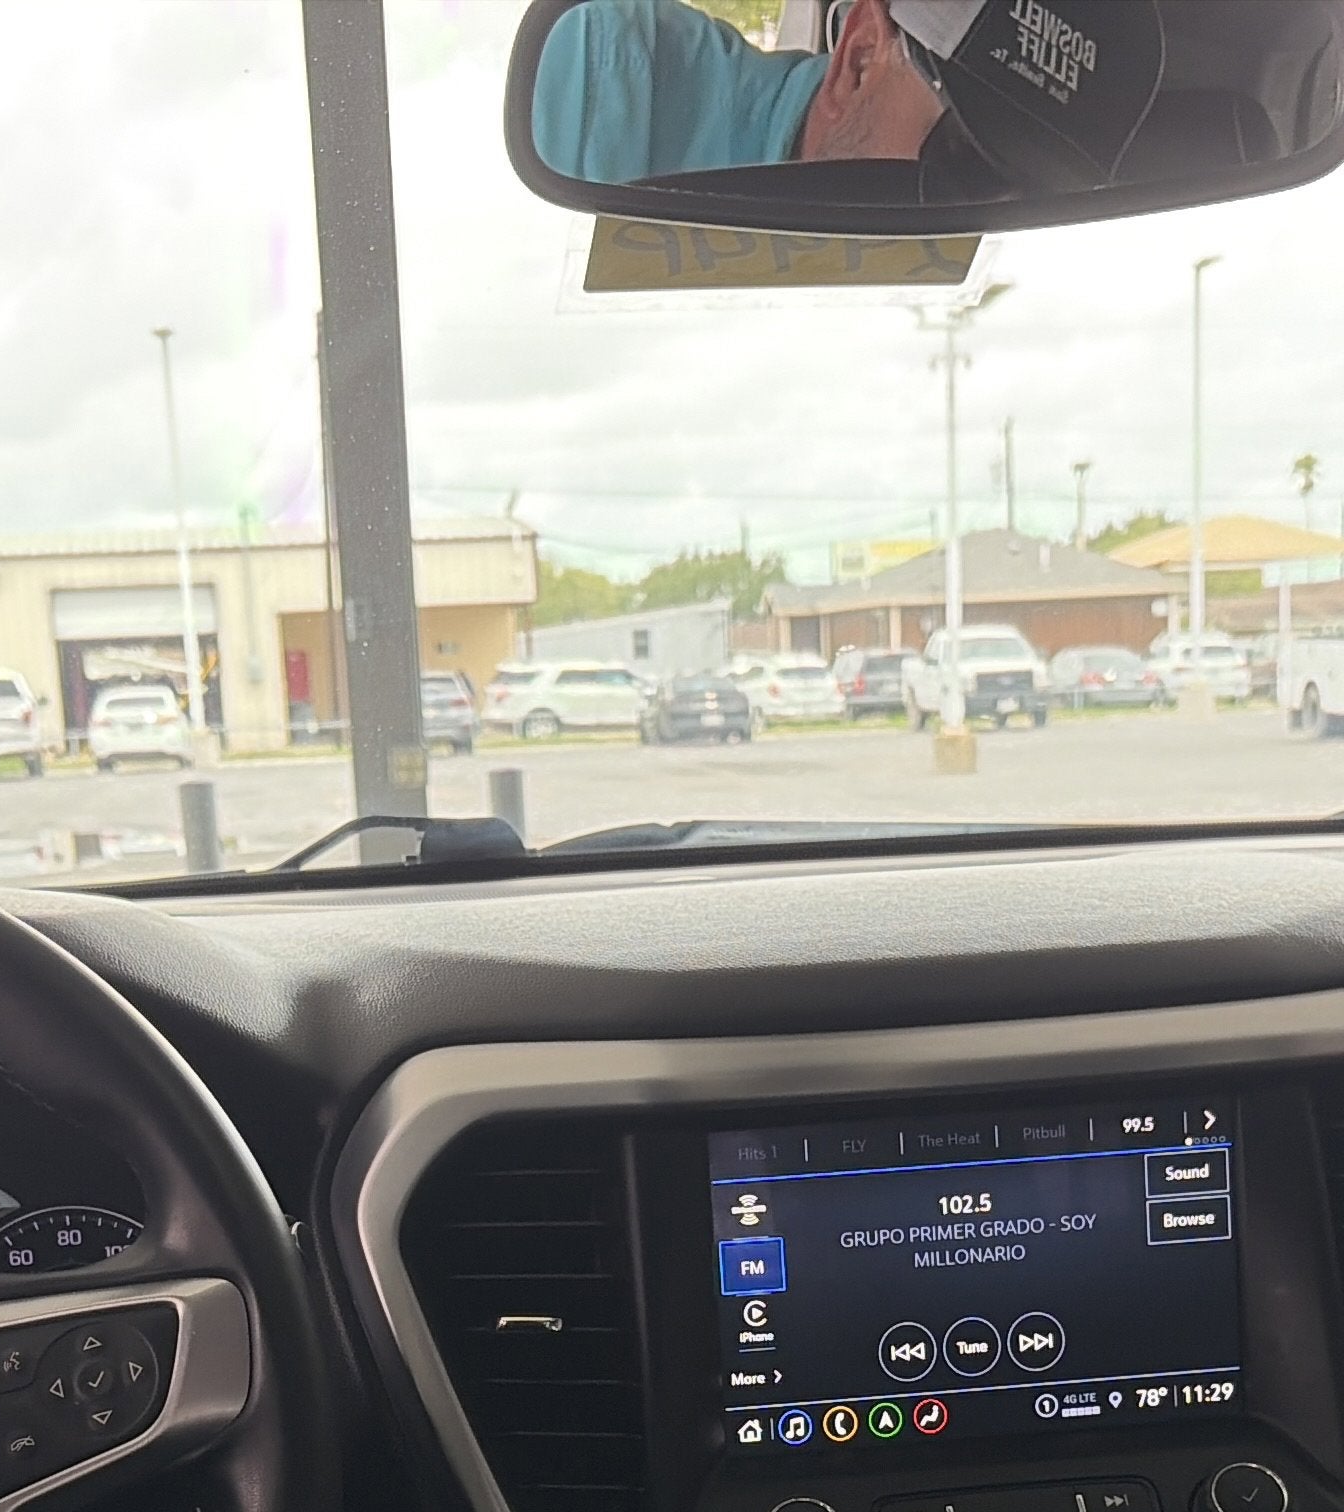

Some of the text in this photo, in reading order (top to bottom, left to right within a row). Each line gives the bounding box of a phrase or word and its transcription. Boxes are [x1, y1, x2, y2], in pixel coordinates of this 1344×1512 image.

[1022, 1124, 1067, 1141] Pitbull
[1122, 1117, 1154, 1134] 99.5
[841, 1139, 867, 1155] FLY
[918, 1131, 981, 1149] The Heat
[737, 1146, 768, 1163] Hits
[1165, 1163, 1209, 1181] Sound
[938, 1193, 992, 1216] 102.5
[1163, 1210, 1215, 1229] Browse
[57, 1229, 82, 1246] 80
[840, 1226, 906, 1249] GRUPO
[909, 1222, 976, 1245] PRIMER
[979, 1218, 1044, 1241] GRADO
[1059, 1213, 1097, 1234] SOY
[9, 1249, 34, 1266] 60
[104, 1245, 132, 1258] 10
[913, 1244, 1026, 1270] MILLONARIO
[740, 1260, 765, 1277] FM
[739, 1330, 775, 1345] iPhone
[956, 1338, 988, 1355] Tune
[731, 1370, 766, 1388] More
[1063, 1392, 1097, 1405] 4G LTE
[1182, 1382, 1234, 1404] 11:29
